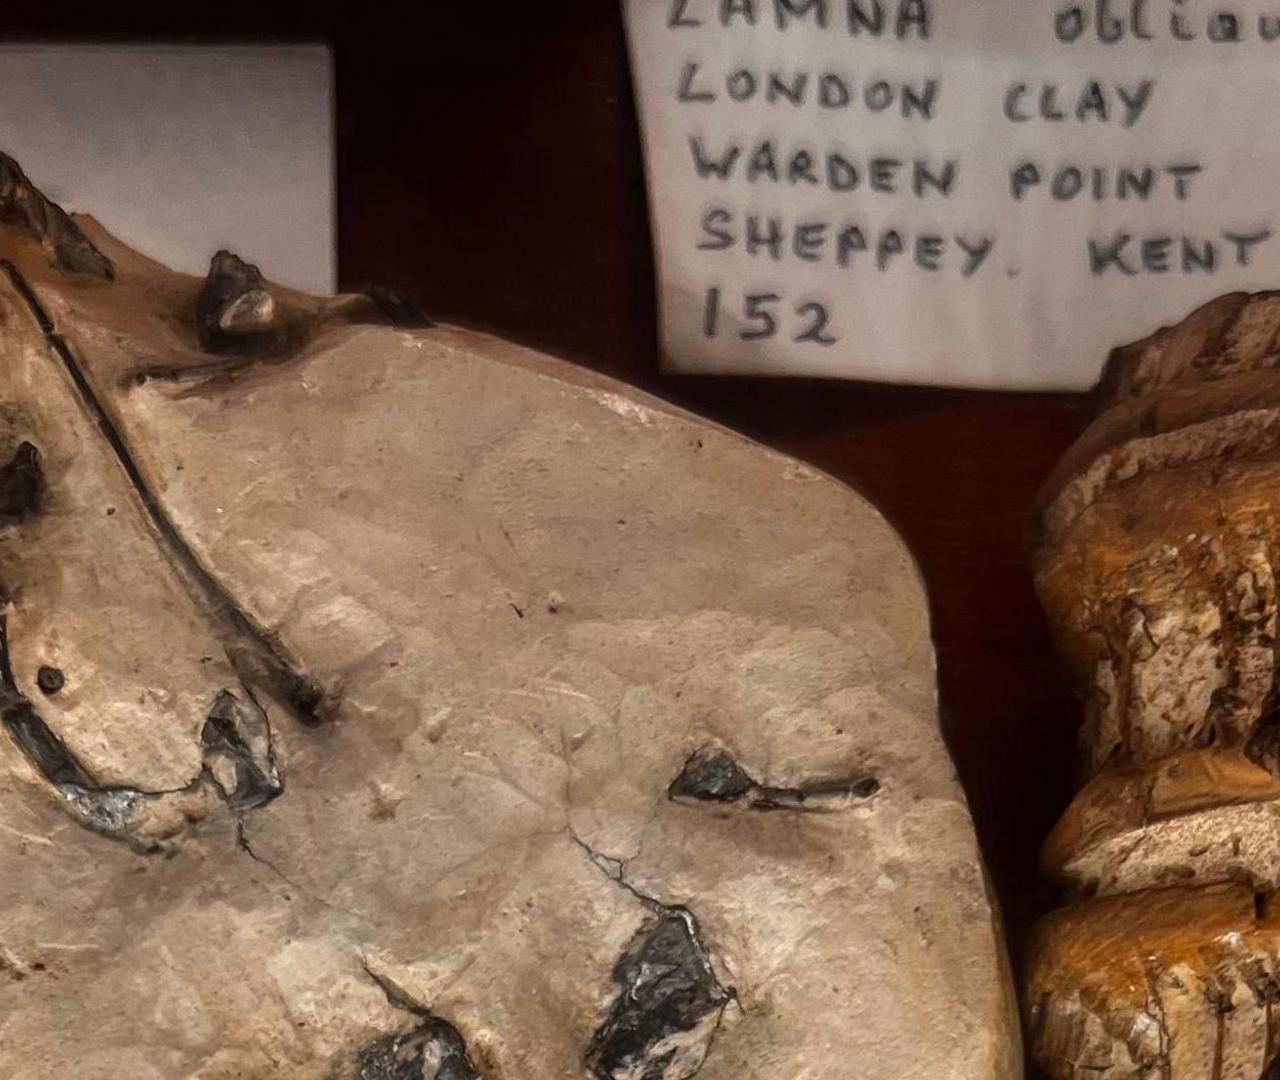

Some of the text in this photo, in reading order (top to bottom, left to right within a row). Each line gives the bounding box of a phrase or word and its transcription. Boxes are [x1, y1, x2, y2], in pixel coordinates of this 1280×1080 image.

[676, 60, 1156, 129] LONDON CLAY
[688, 136, 1204, 202] WARDEN POINT
[1087, 226, 1273, 277] KENT
[704, 286, 837, 346] 152
